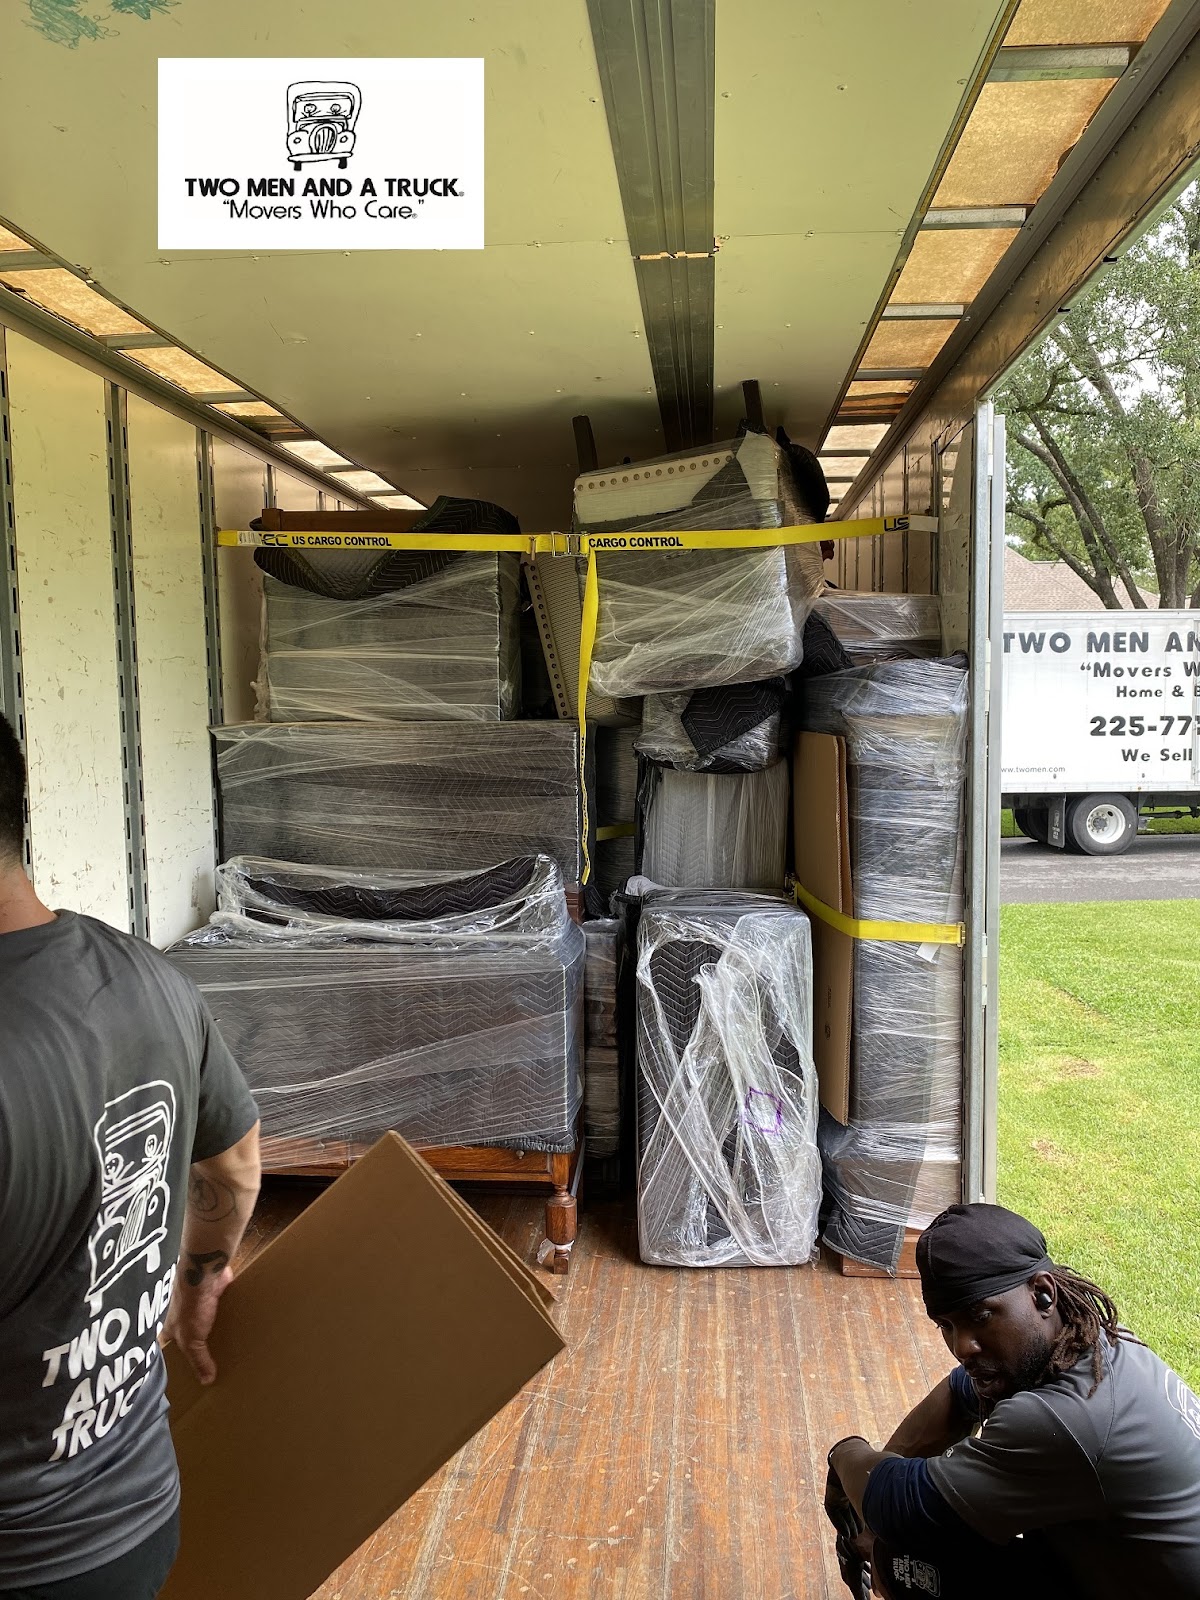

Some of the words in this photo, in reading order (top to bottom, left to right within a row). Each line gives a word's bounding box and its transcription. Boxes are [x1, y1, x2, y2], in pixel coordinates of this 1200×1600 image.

[292, 536, 304, 545] US
[307, 536, 341, 546] CARGO
[344, 537, 392, 547] CONTROL
[588, 538, 627, 548] CARGO
[629, 536, 684, 547] CONTROL
[1003, 632, 1072, 654] TWO
[1086, 631, 1149, 653] MEN
[1116, 685, 1163, 698] Home
[1172, 685, 1185, 698] &
[1122, 749, 1151, 762] We
[1160, 748, 1192, 761] Sell
[42, 1308, 130, 1387] TWO
[62, 1346, 146, 1425] AND
[49, 1371, 150, 1461] TRUC
